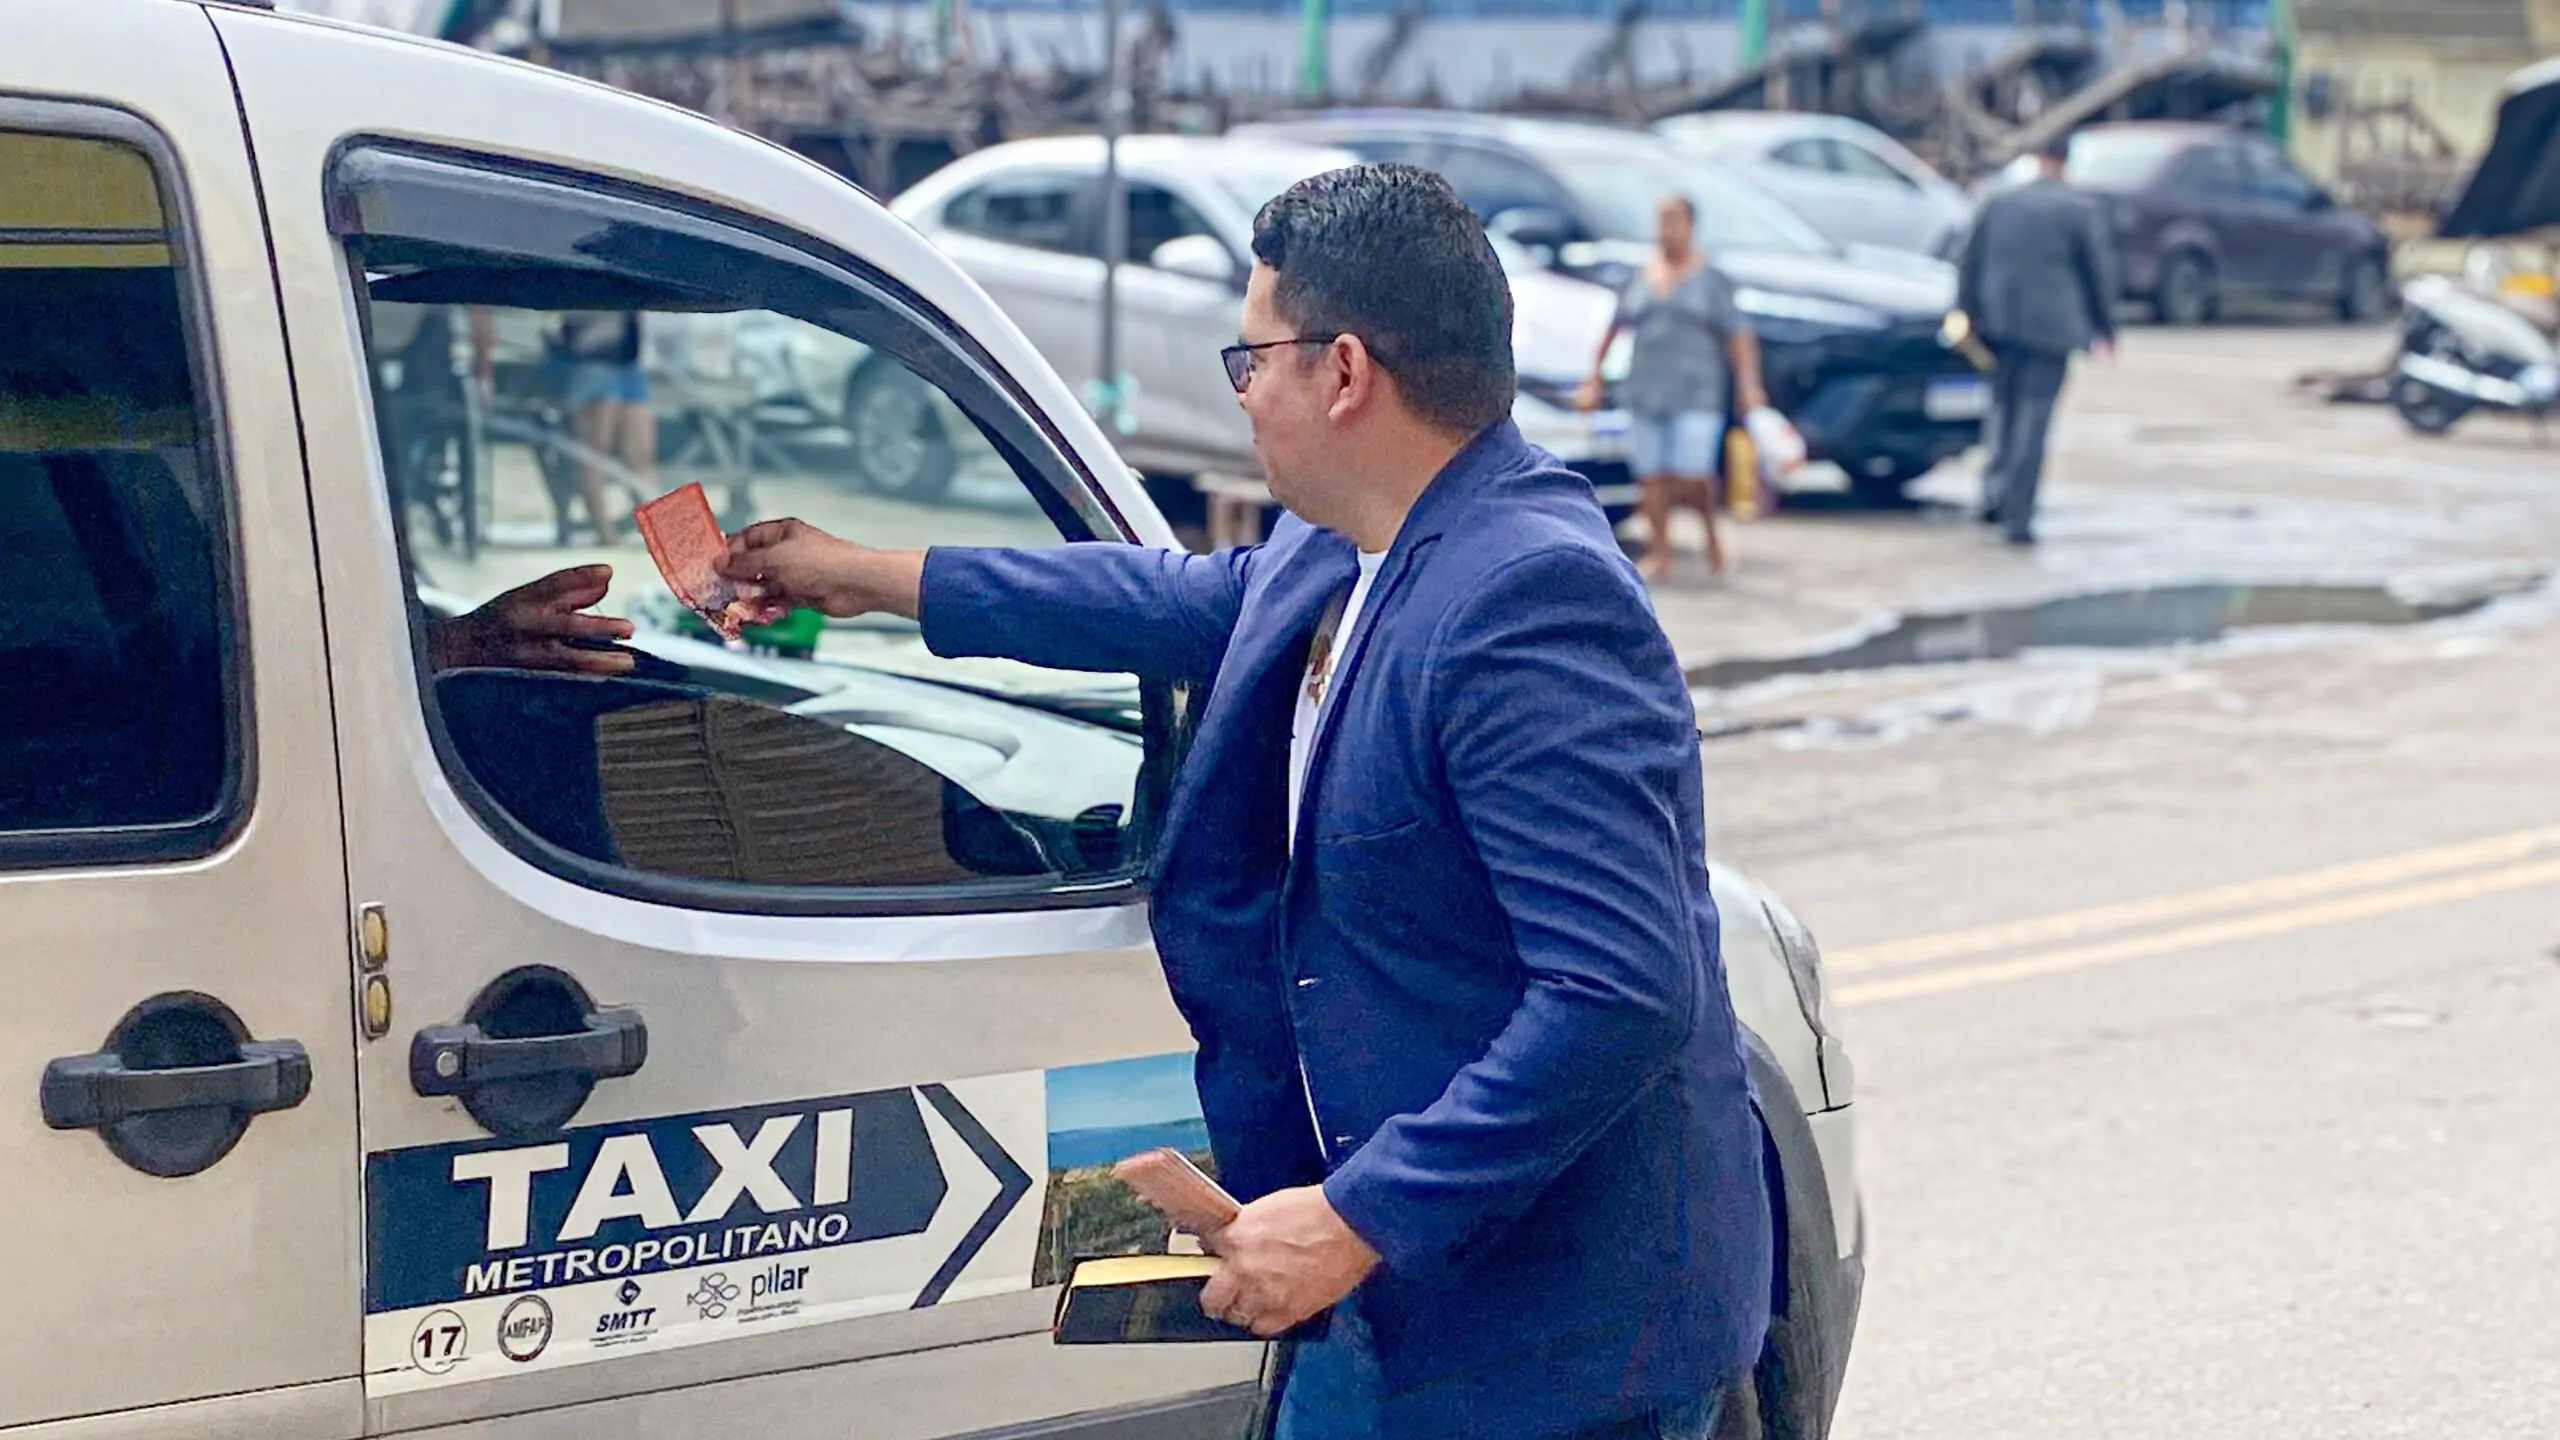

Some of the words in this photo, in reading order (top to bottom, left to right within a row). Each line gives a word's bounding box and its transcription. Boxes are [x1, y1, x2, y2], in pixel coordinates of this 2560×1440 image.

[453, 1109, 853, 1251] TAXI
[465, 1214, 848, 1294] METROPOLITANO
[751, 1265, 809, 1306] pilar
[597, 1308, 656, 1333] SMTT
[417, 1326, 461, 1360] 17
